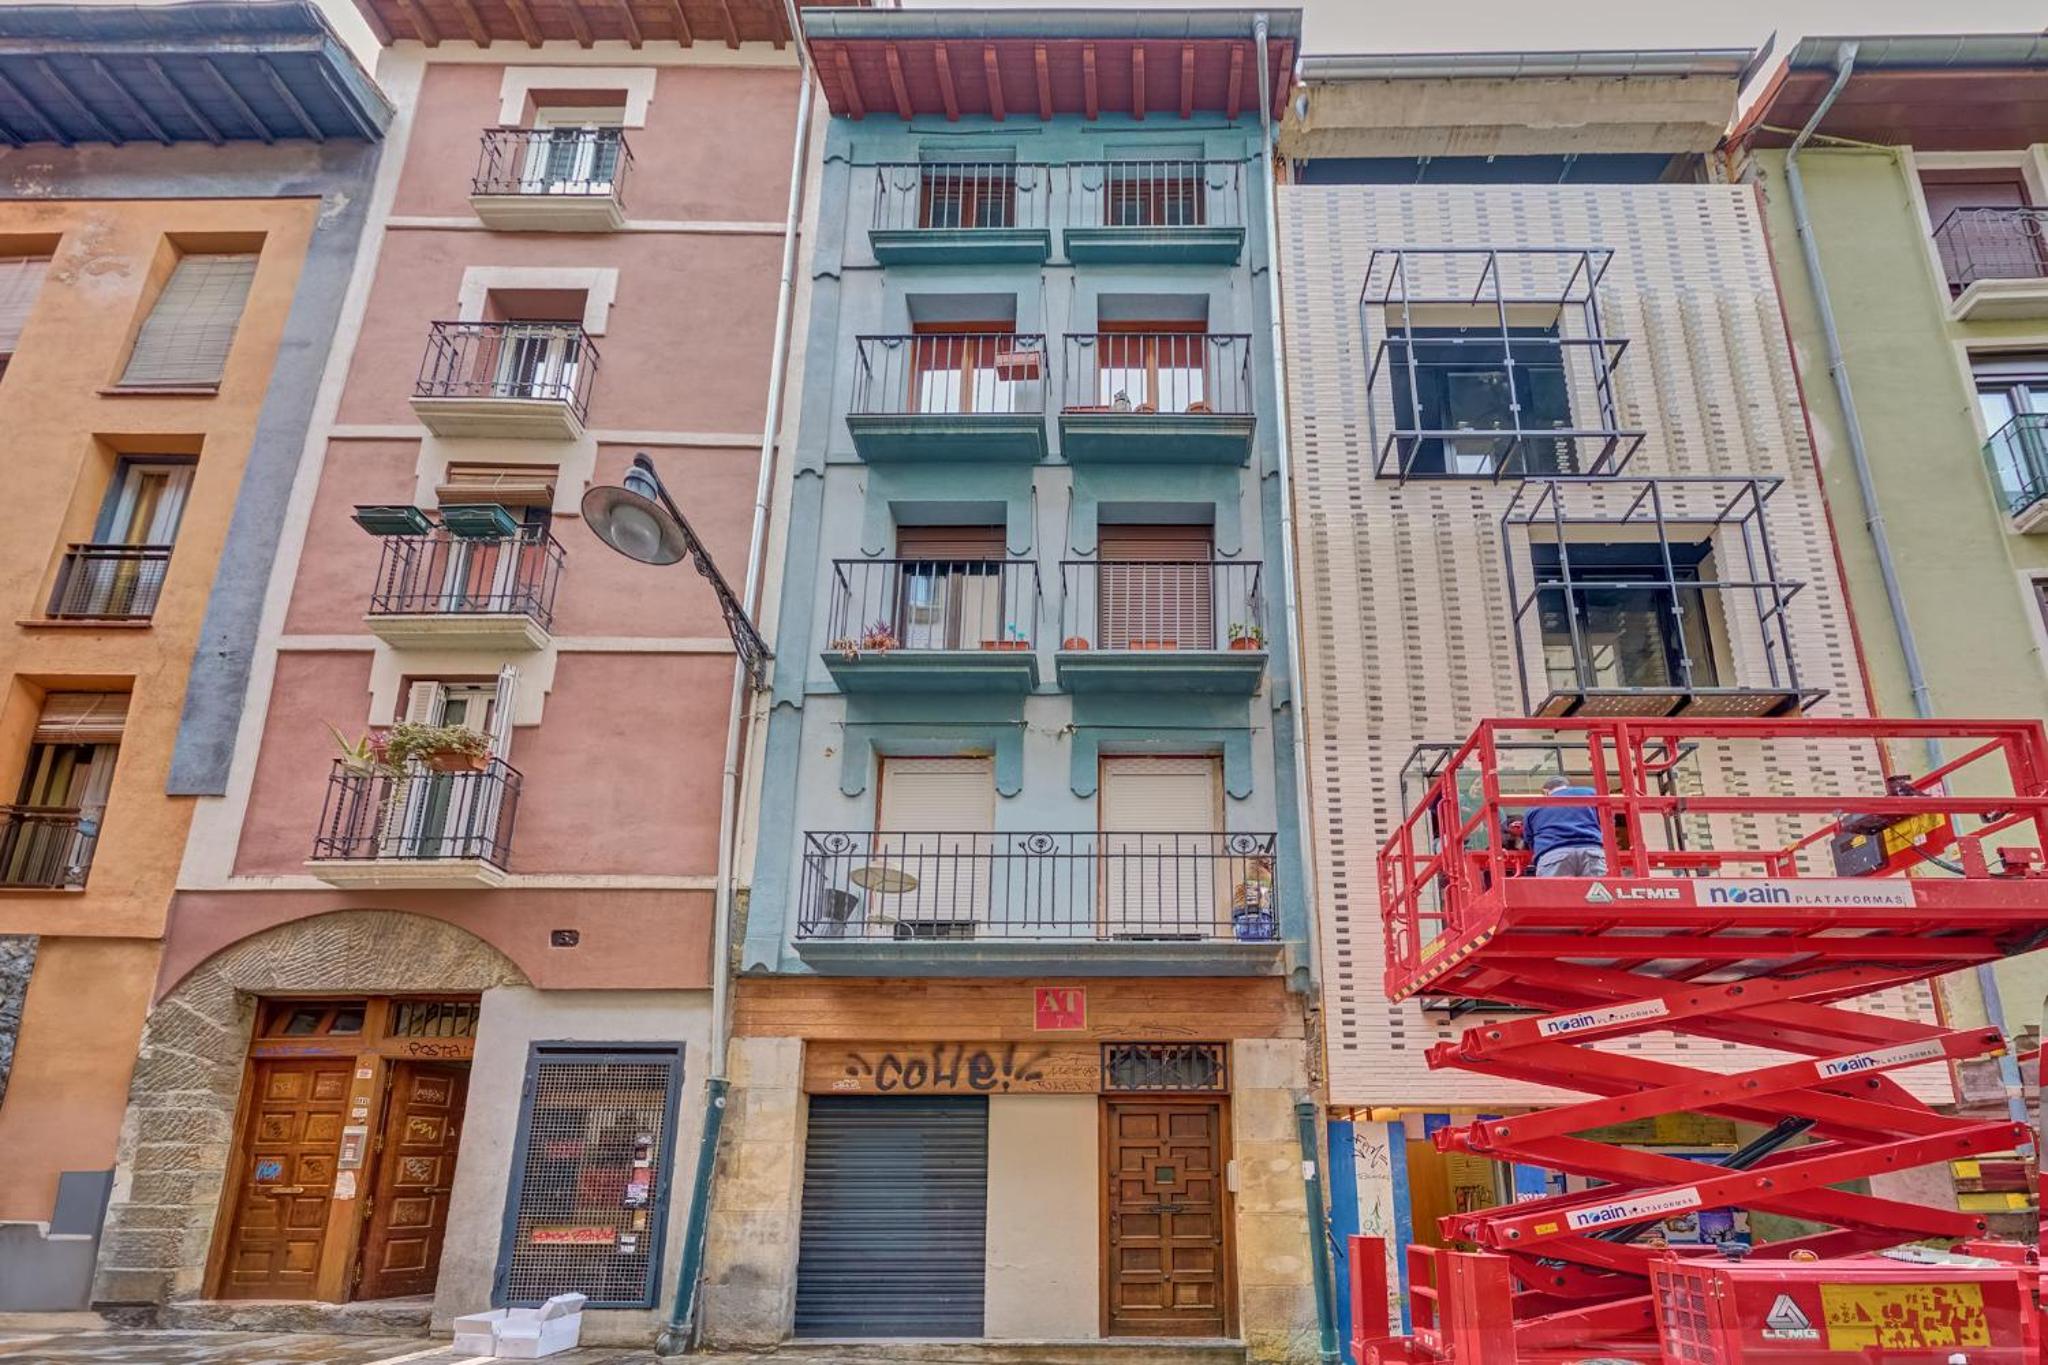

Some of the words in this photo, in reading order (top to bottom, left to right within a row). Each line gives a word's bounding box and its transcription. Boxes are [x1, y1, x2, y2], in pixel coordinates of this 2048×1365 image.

[1710, 883, 1792, 904] noain
[1795, 895, 1904, 905] PLATAFORMAS
[1040, 990, 1082, 1012] AT
[1548, 1013, 1595, 1034] noain
[1825, 1054, 1874, 1075] noain
[1577, 1205, 1627, 1226] noain
